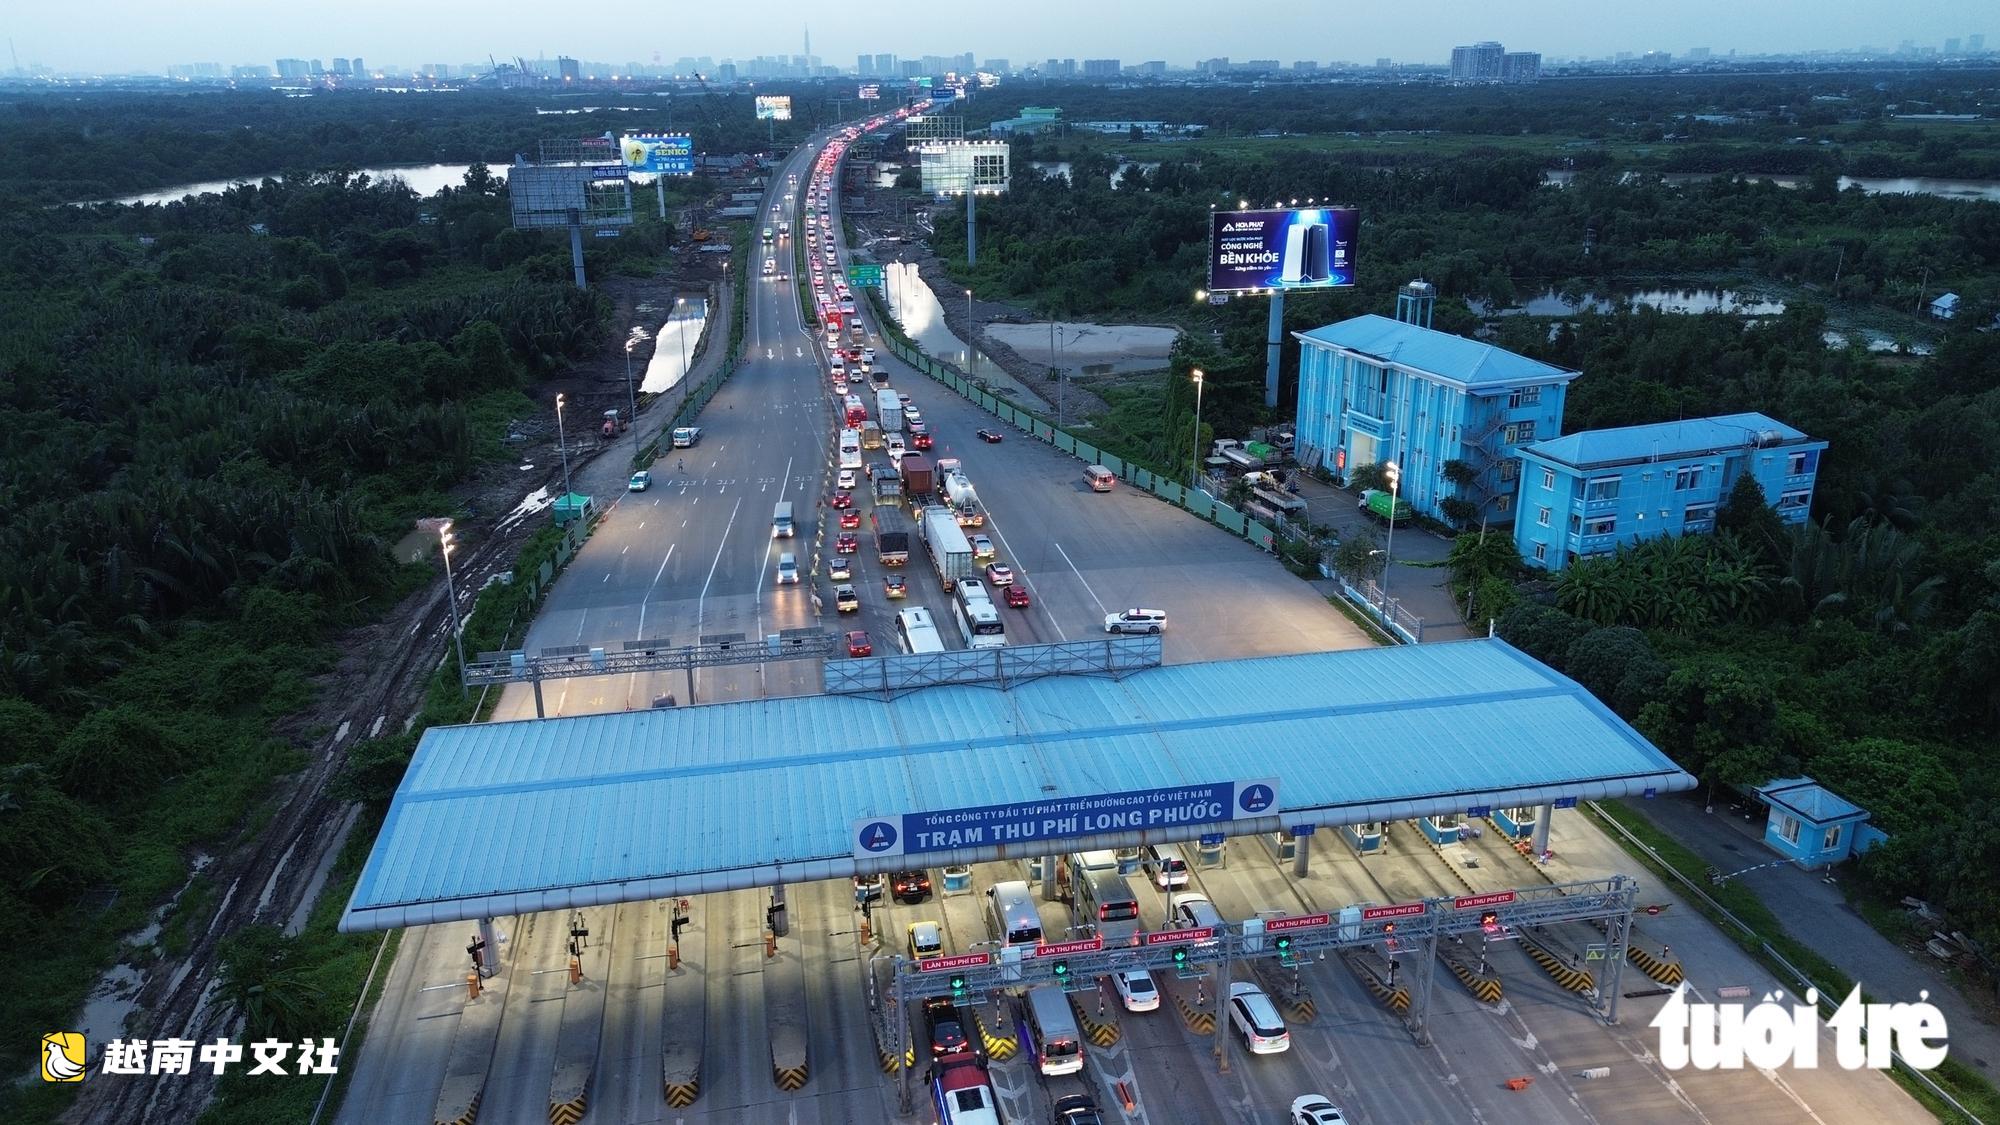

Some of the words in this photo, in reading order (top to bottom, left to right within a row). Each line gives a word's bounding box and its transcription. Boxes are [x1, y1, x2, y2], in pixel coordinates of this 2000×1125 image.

[1221, 242, 1242, 250] CÔNG
[1243, 241, 1263, 250] NGHỆ
[1220, 251, 1244, 264] BỀN
[1246, 250, 1279, 263] KHỎE
[925, 814, 952, 825] TỔNG
[955, 811, 981, 822] CÔNG
[984, 811, 997, 820] TY
[1022, 806, 1035, 816] TƯ
[1037, 802, 1062, 814] PHÁT
[1064, 797, 1092, 810] TRIỂN
[1127, 796, 1144, 805] CAO
[1146, 791, 1165, 803] TỐC
[1168, 791, 1189, 802] VIỆT
[1191, 789, 1212, 798] NAM
[916, 827, 983, 848] TRẠM
[991, 821, 1035, 840] THU
[1043, 813, 1078, 835] PHÍ
[1084, 810, 1142, 831] LONG
[1149, 800, 1223, 824] PHƯỚC
[1153, 934, 1167, 942] LÀN
[1041, 946, 1055, 954] LÀN
[1071, 943, 1083, 951] PHÍ
[958, 957, 969, 965] PHÍ
